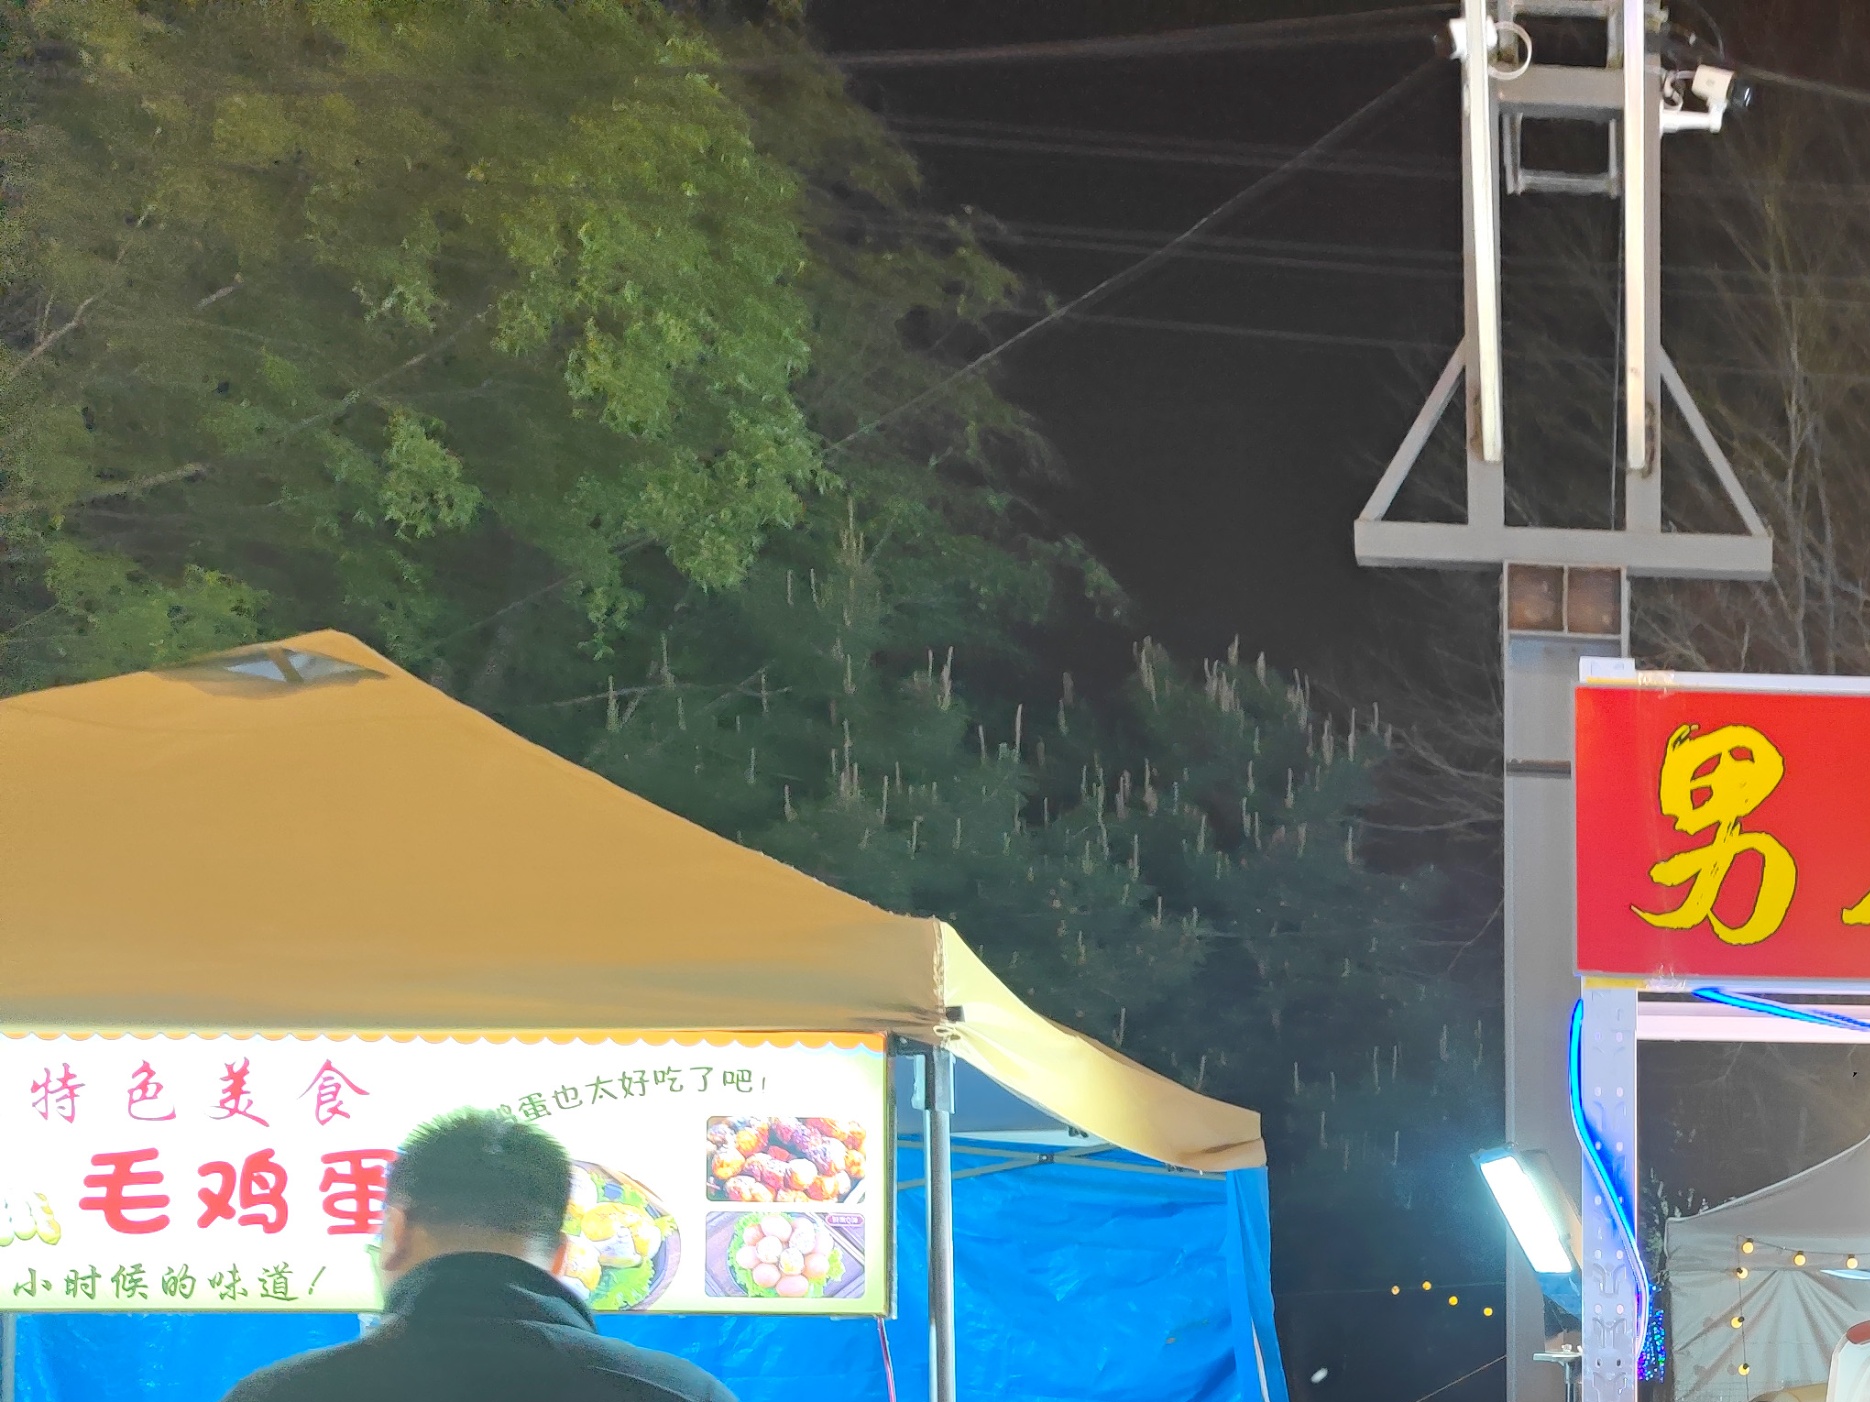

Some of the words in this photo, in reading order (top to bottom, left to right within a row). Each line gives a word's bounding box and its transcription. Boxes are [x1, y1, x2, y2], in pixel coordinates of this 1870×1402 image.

[30, 1058, 371, 1128] 特色美食
[79, 1147, 402, 1236] 毛鸡蛋
